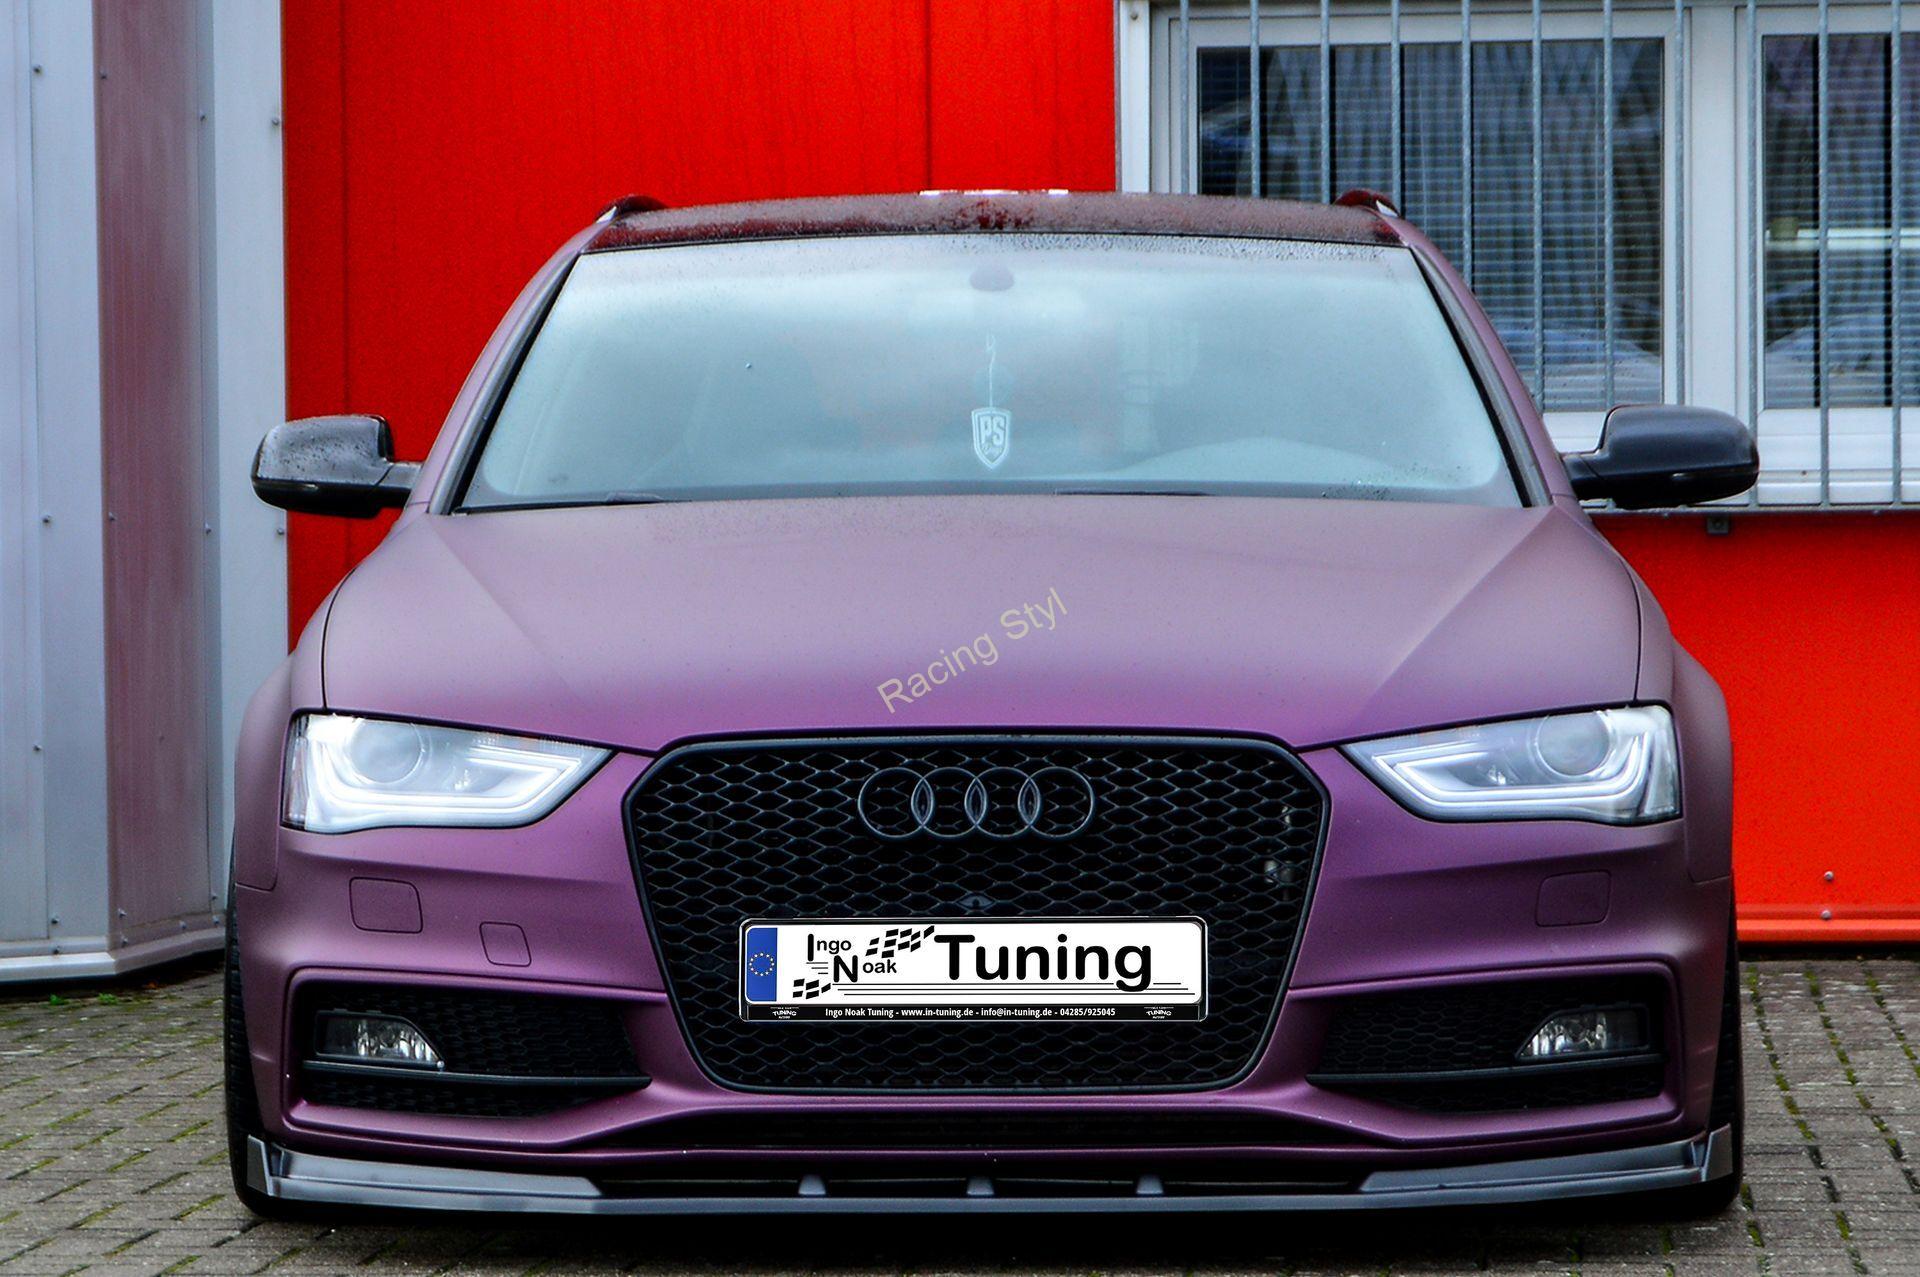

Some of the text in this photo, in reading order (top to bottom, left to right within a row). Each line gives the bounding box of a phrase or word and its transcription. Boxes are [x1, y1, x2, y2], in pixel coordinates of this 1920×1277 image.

[980, 416, 1005, 445] PS
[807, 933, 852, 961] Ingo
[833, 955, 898, 983] Noak
[933, 933, 1152, 993] Tuning
[825, 1008, 843, 1018] Ingo
[845, 1008, 866, 1016] Noak
[868, 1008, 894, 1018] Tuning
[901, 1008, 974, 1018] www.in-tuning.de
[981, 1008, 1053, 1018] info@in-tuning.de
[1060, 1008, 1116, 1017] 04285/925045
